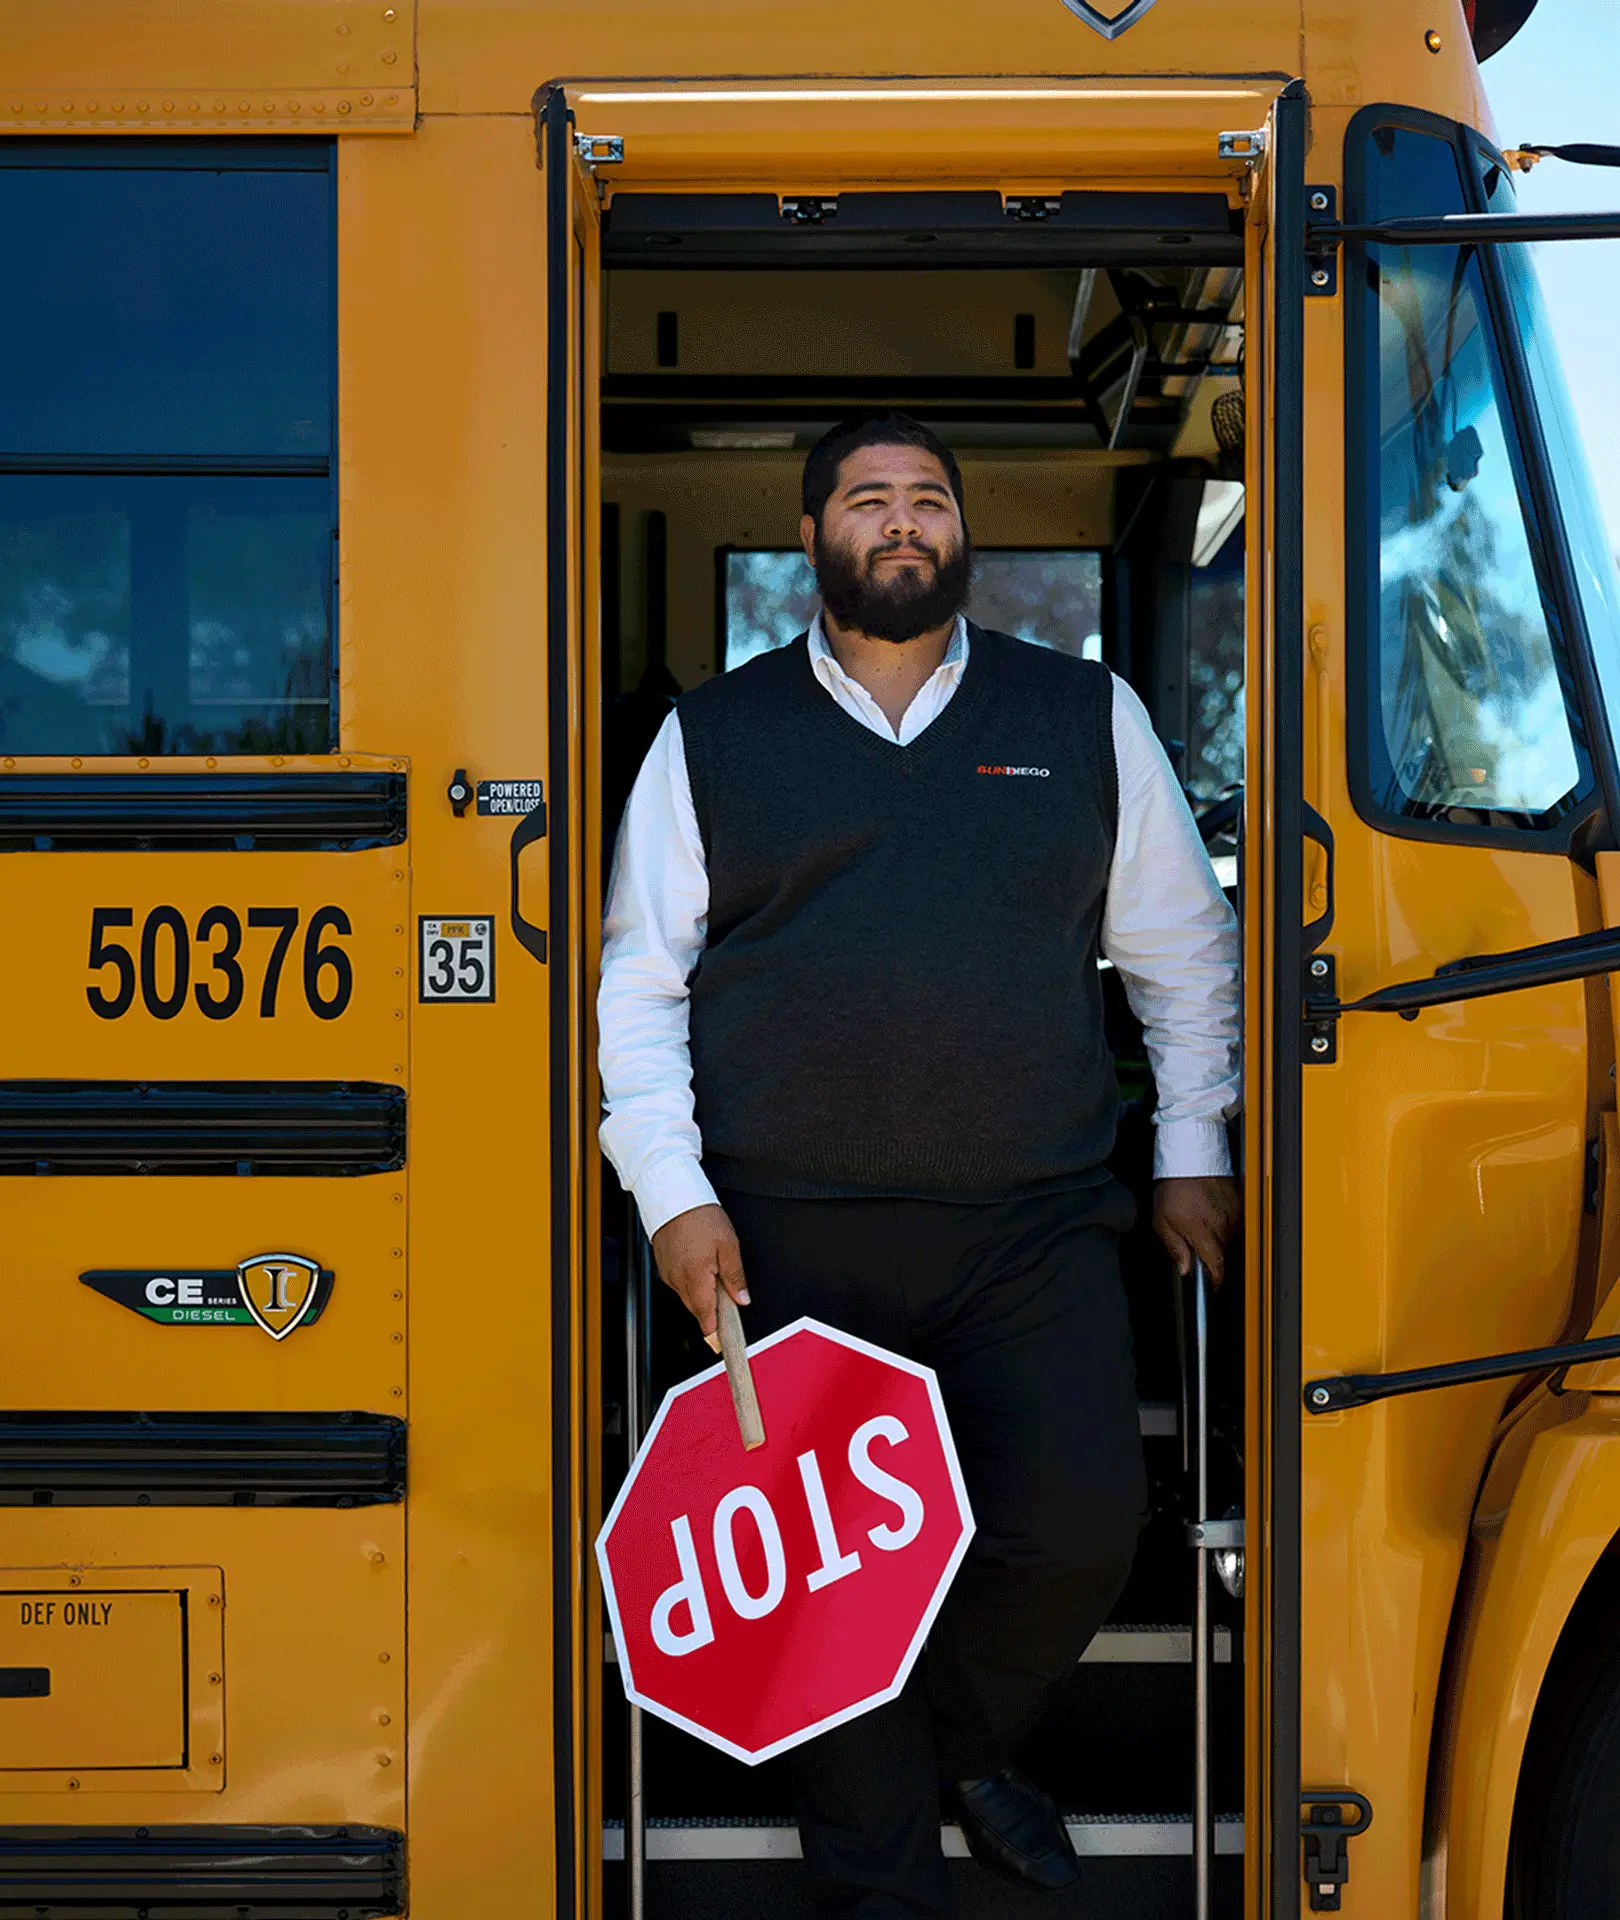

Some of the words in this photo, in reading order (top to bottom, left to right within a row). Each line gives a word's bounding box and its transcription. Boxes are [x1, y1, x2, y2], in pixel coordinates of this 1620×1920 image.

[490, 783, 540, 798] POWERED
[86, 905, 353, 1020] 50376
[428, 939, 485, 994] 35
[145, 1277, 204, 1305] CE
[207, 1297, 237, 1305] SERIES
[172, 1309, 236, 1321] DIESEL
[650, 1415, 925, 1657] STOP
[21, 1602, 56, 1625] DEF
[63, 1602, 113, 1625] ONLY
